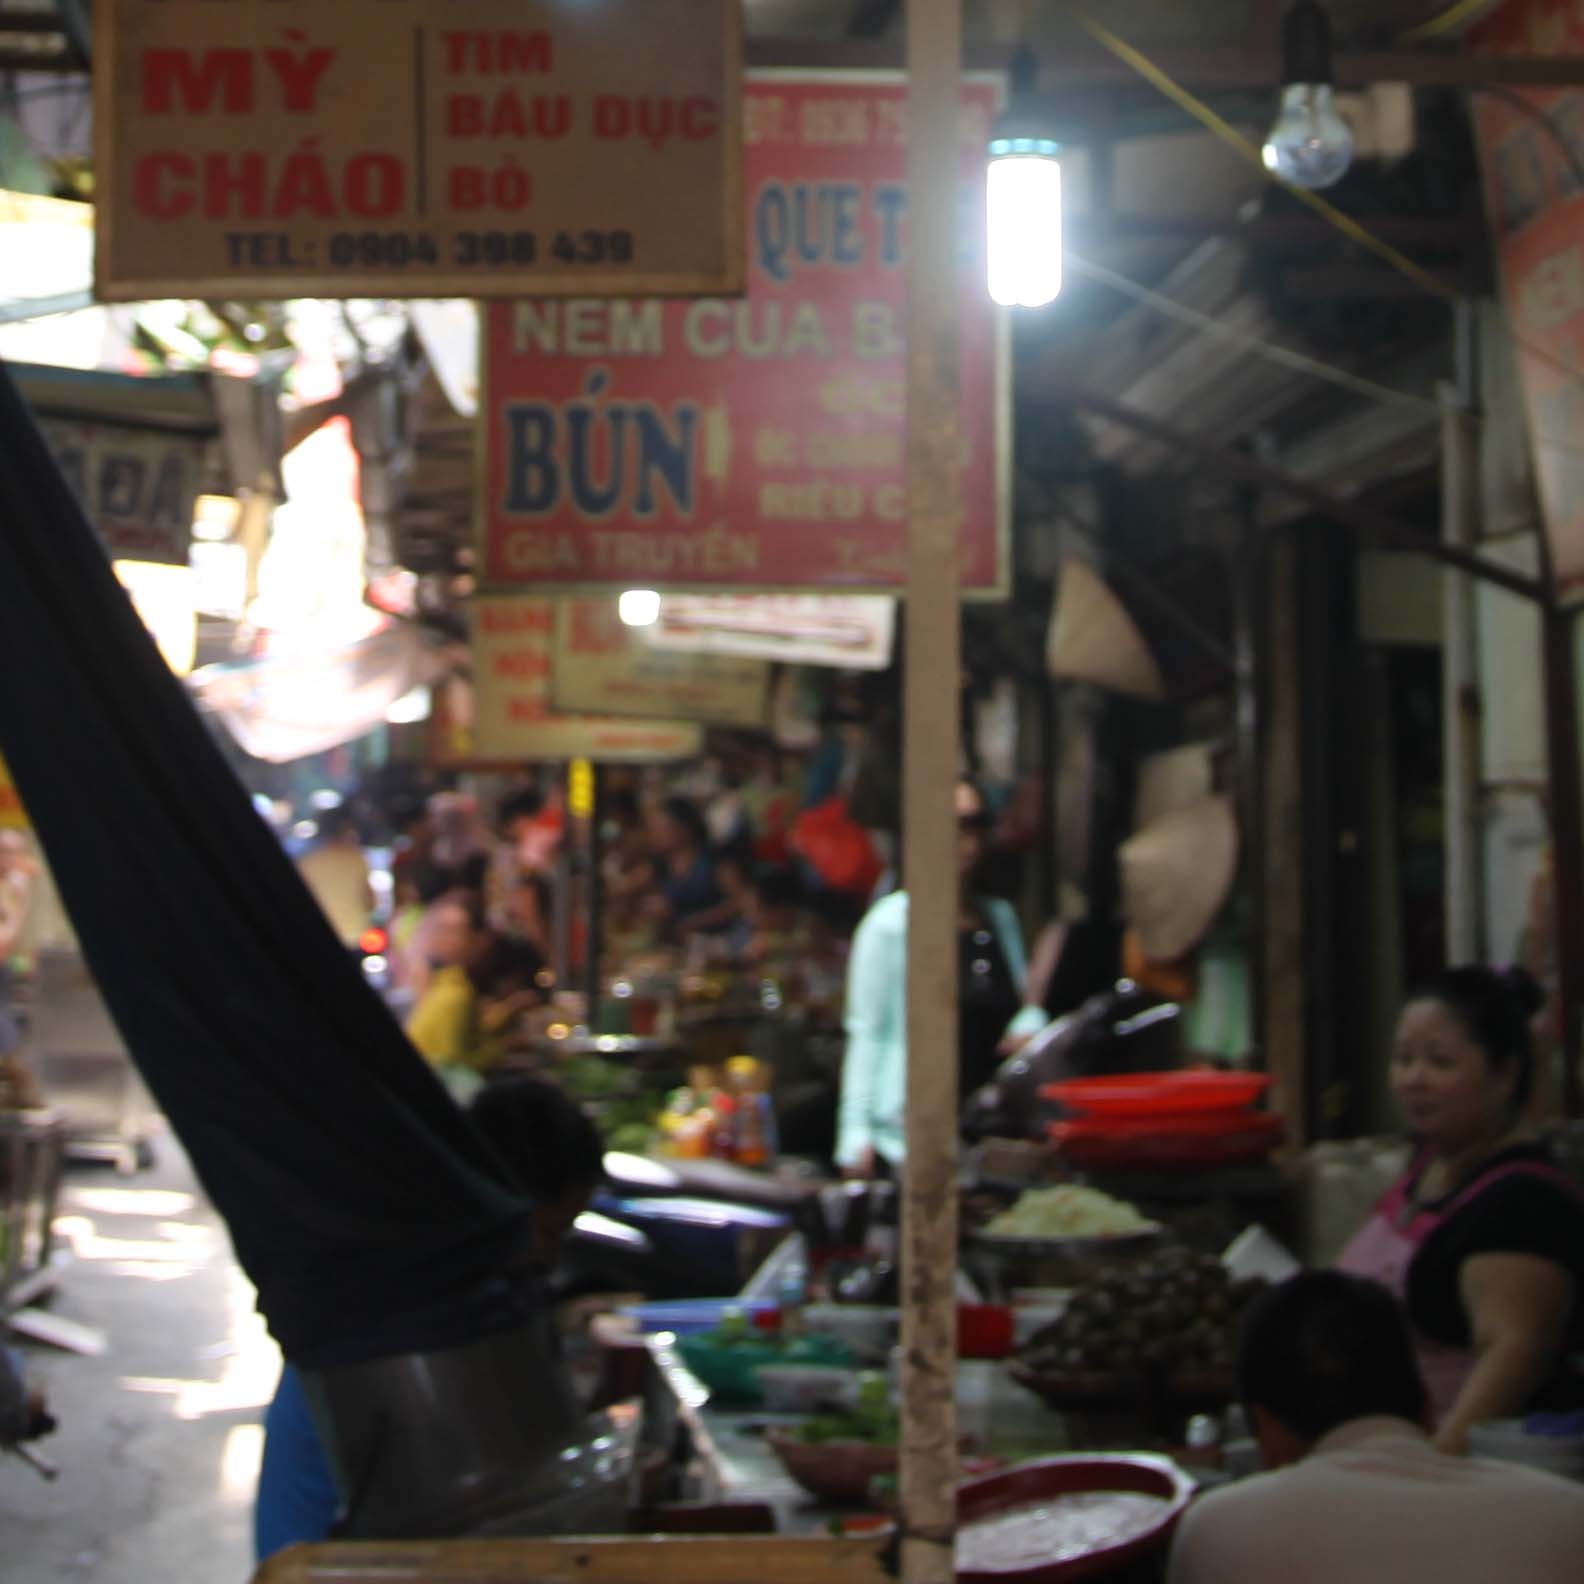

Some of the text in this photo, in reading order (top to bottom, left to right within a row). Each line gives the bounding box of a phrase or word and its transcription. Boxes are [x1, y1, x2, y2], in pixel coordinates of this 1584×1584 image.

[142, 27, 336, 113] MỲ
[444, 30, 552, 76] TIM
[593, 95, 718, 151] DỤC
[134, 133, 405, 222] CHÁO
[449, 152, 530, 211] BÒ
[224, 231, 317, 268] TEL:
[552, 229, 634, 265] 439
[683, 296, 833, 358] CUA
[504, 367, 697, 515] BÚN
